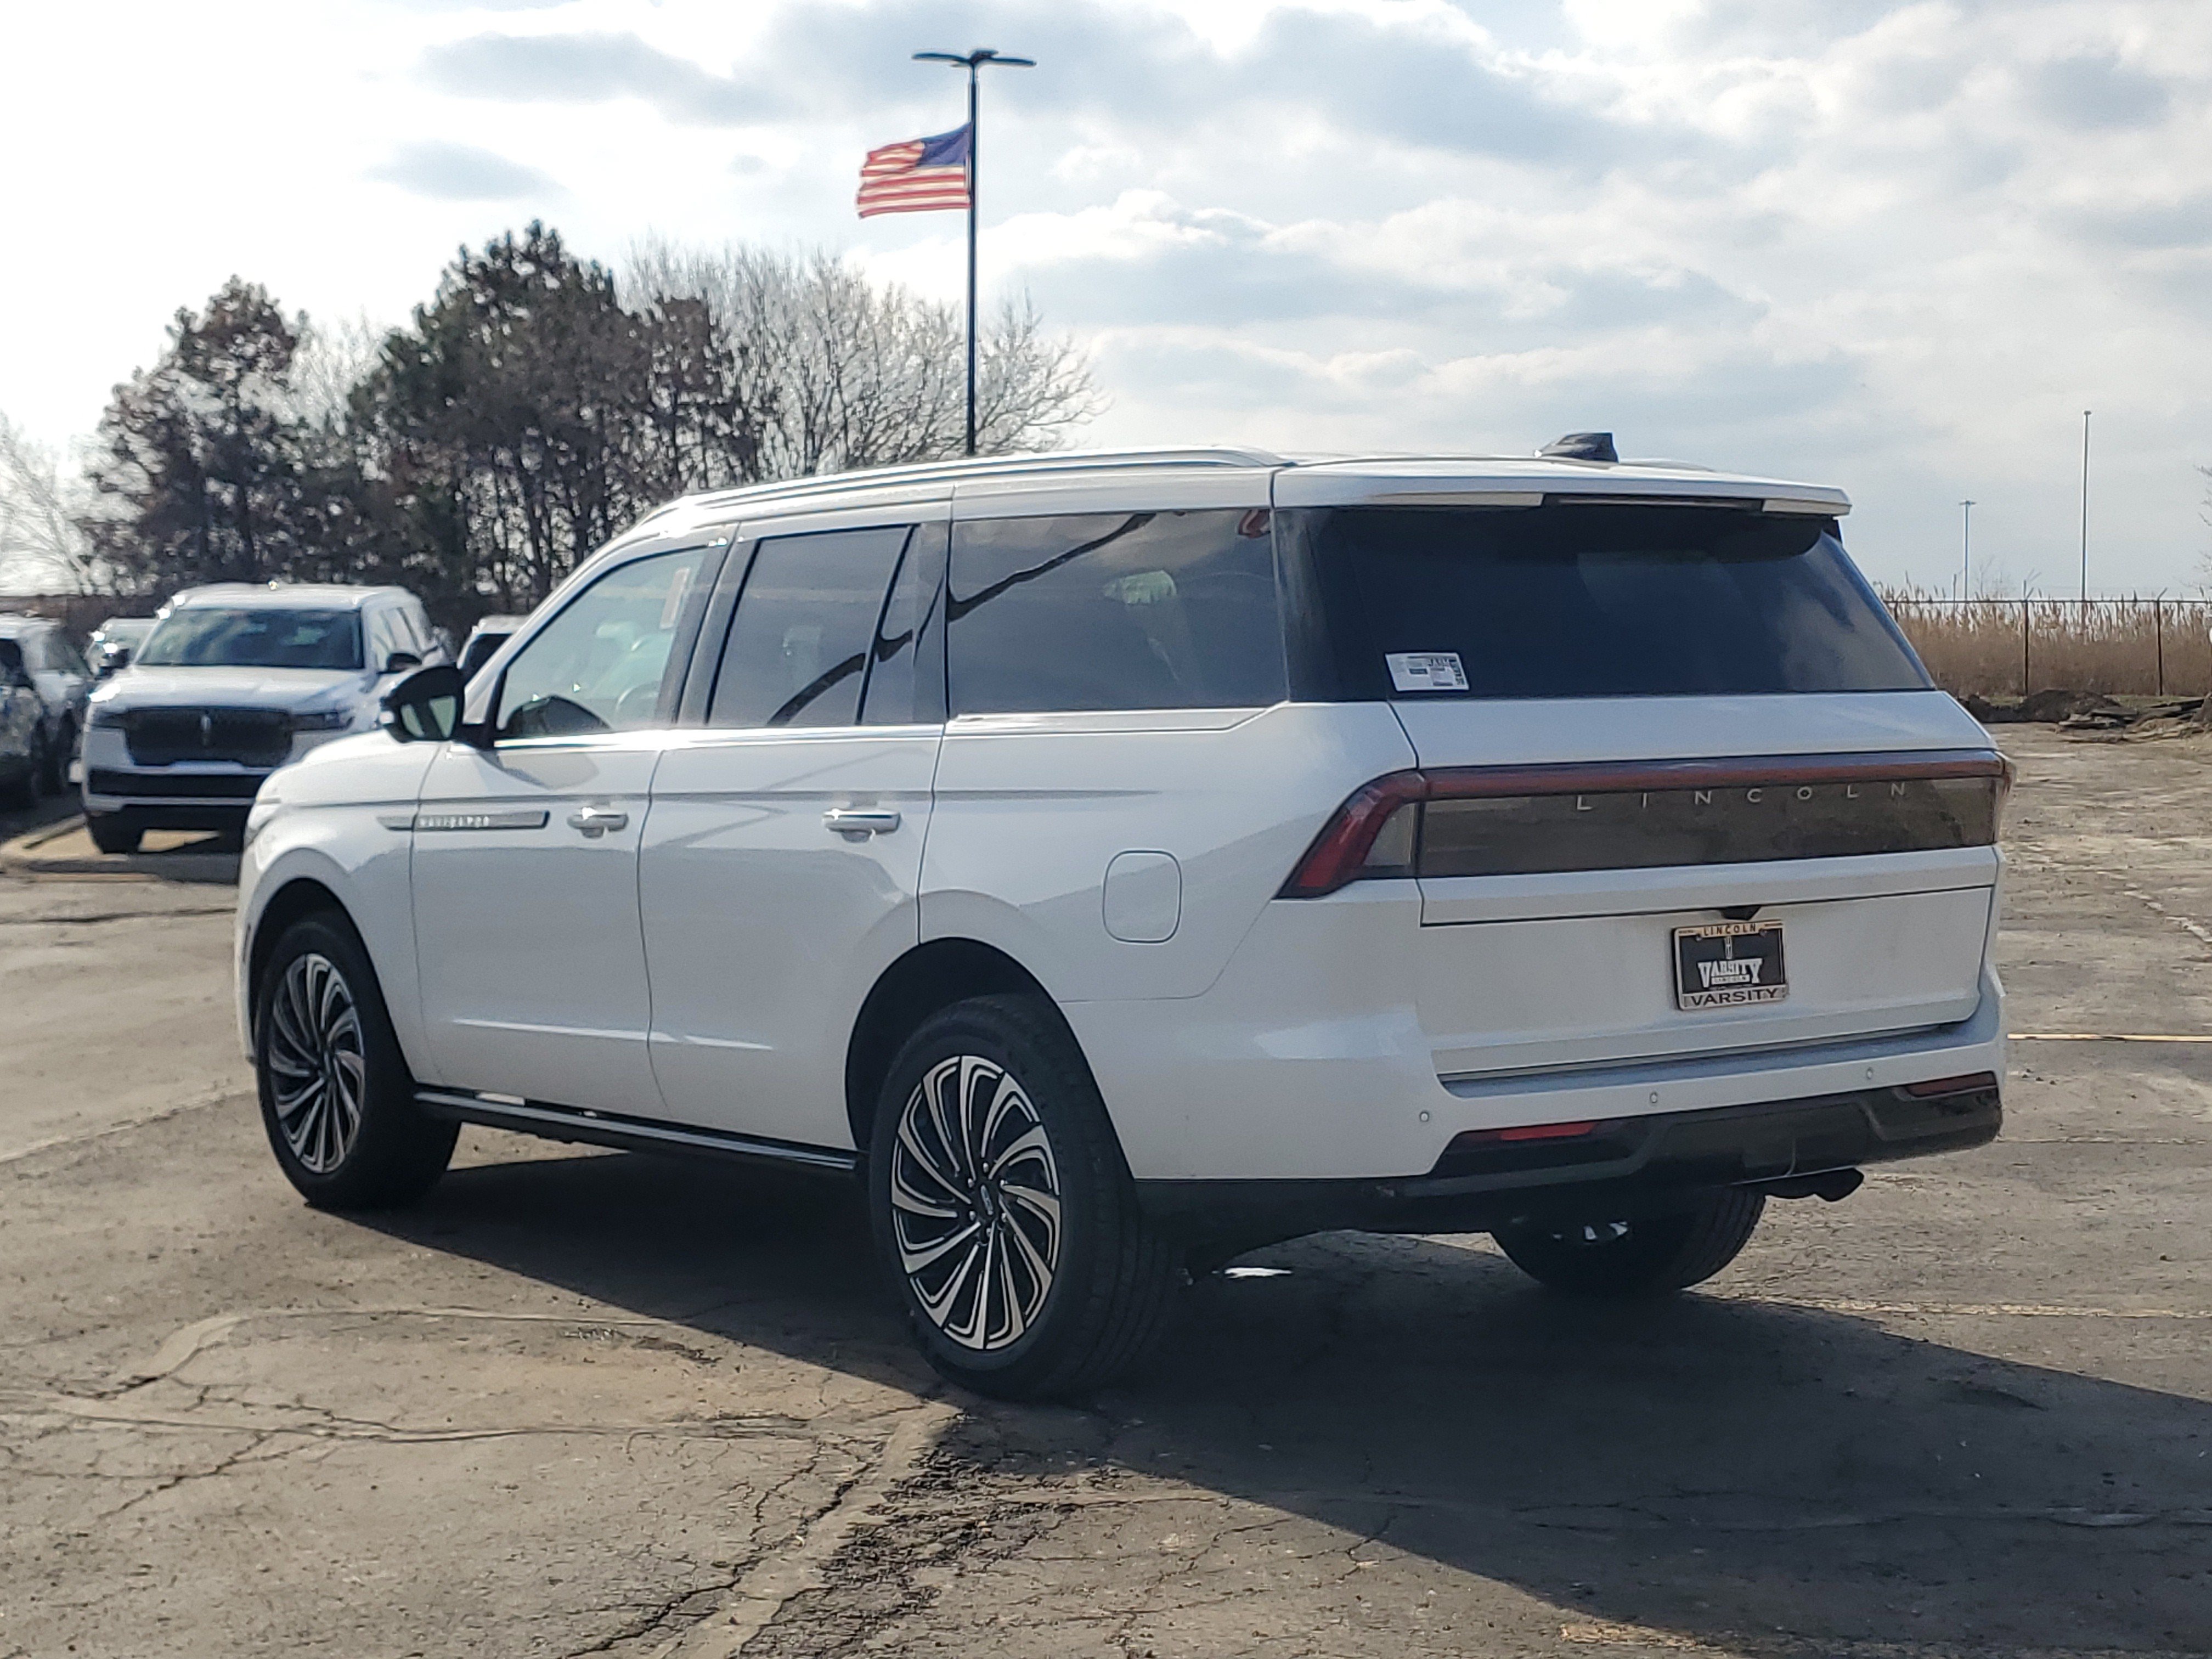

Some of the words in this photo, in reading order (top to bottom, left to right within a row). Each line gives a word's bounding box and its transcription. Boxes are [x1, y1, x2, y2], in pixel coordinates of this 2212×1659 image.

[1576, 782, 1905, 811] LINCOLN
[1703, 923, 1756, 936] LINCOLN
[1697, 957, 1763, 988] VARSITY
[1691, 988, 1779, 1006] VARSITY
